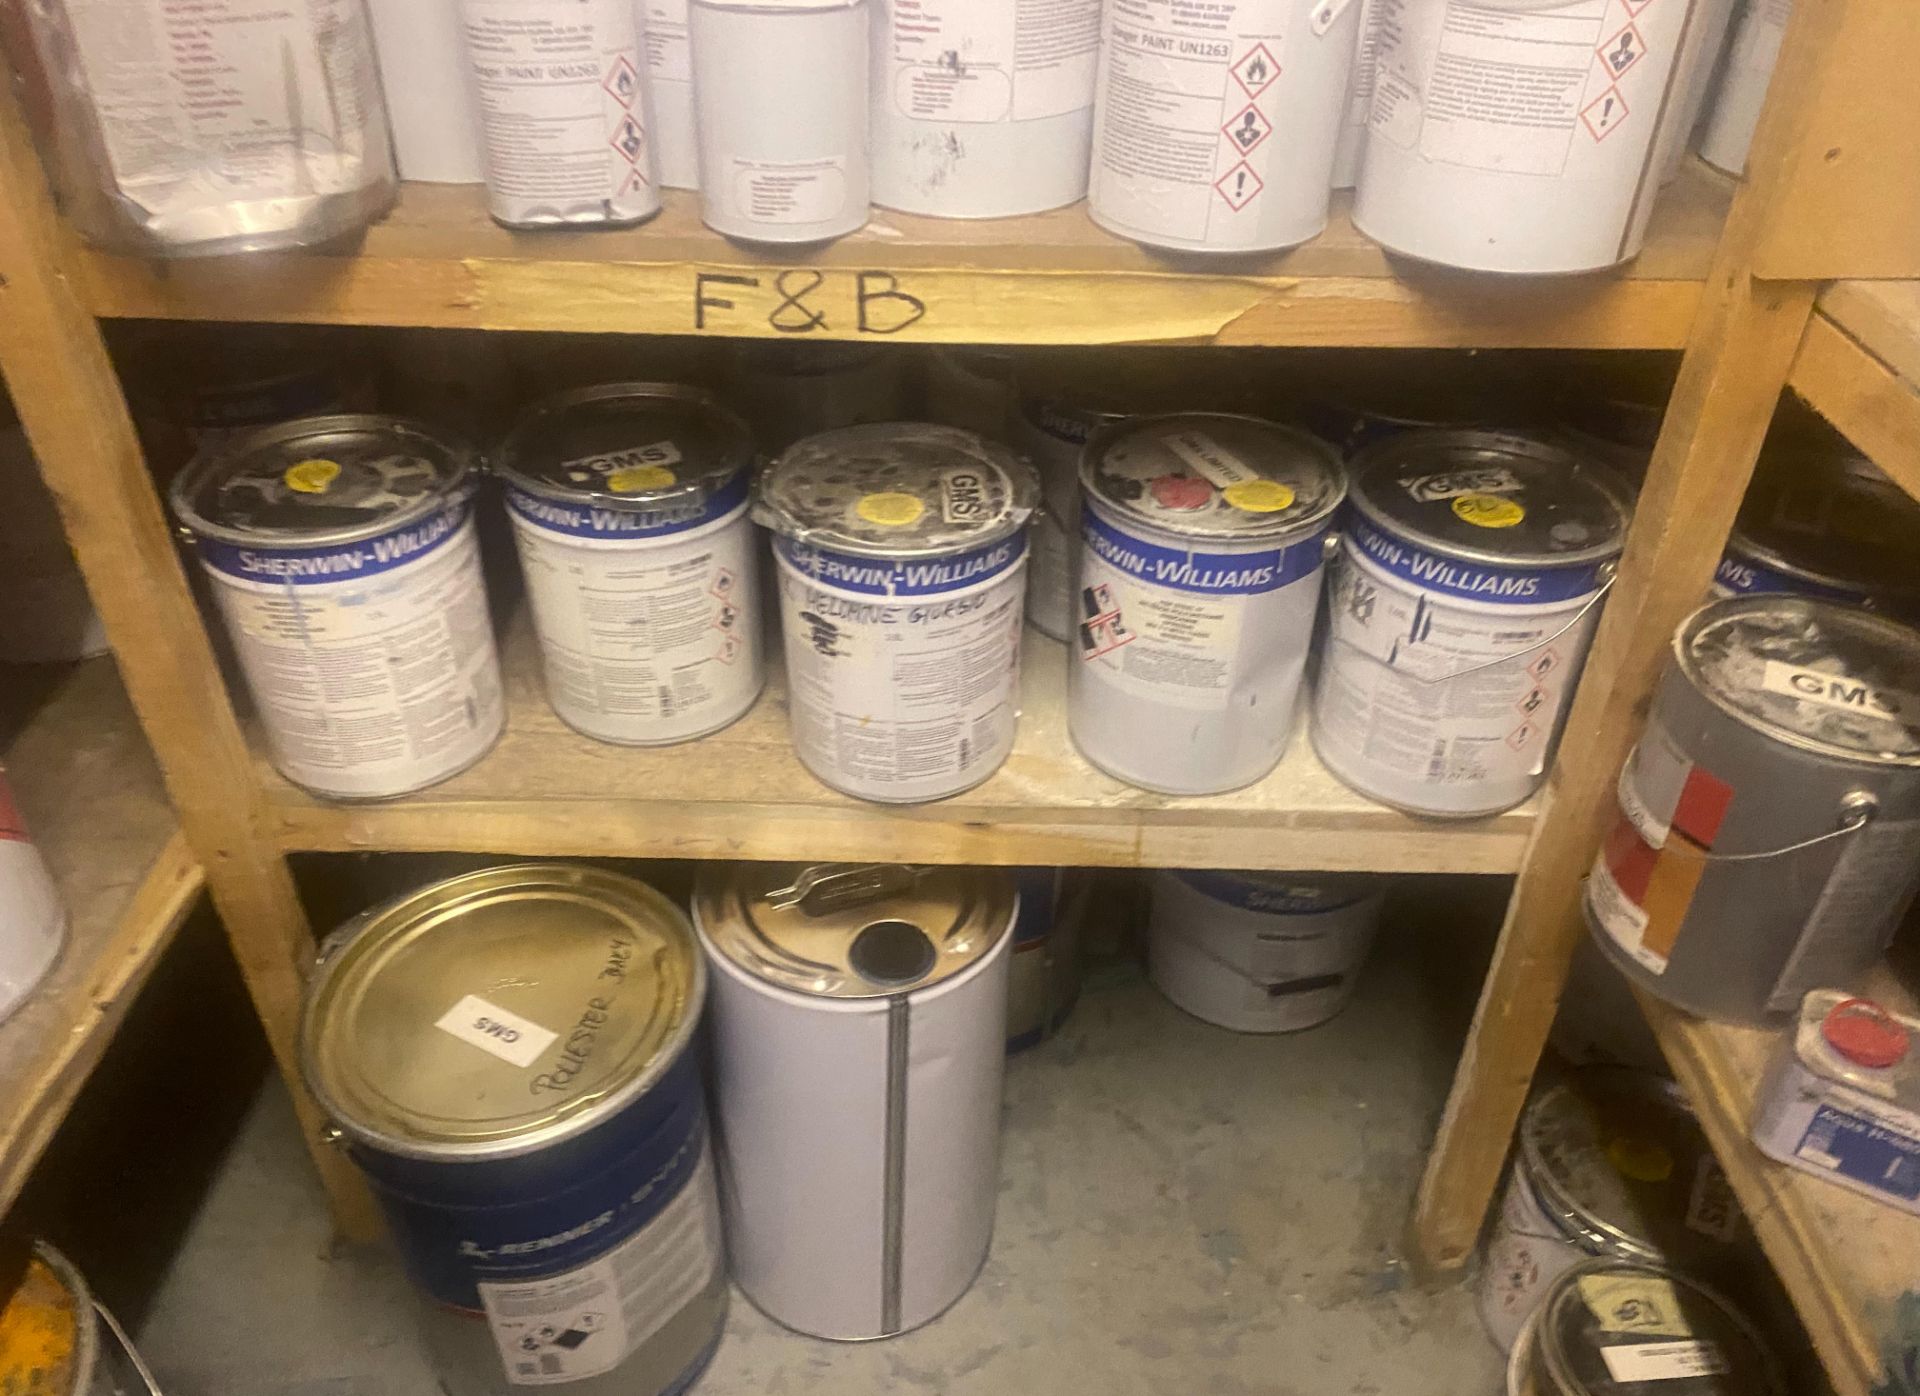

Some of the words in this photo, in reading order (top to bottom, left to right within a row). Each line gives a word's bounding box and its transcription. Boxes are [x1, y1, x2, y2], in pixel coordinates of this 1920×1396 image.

[1141, 33, 1175, 52] PAINT
[1179, 39, 1230, 58] UN1263
[696, 273, 759, 329] F
[769, 269, 830, 333] &
[857, 270, 926, 334] B
[589, 448, 668, 473] GMS
[950, 474, 984, 523] GMS
[472, 1015, 521, 1045] GMS
